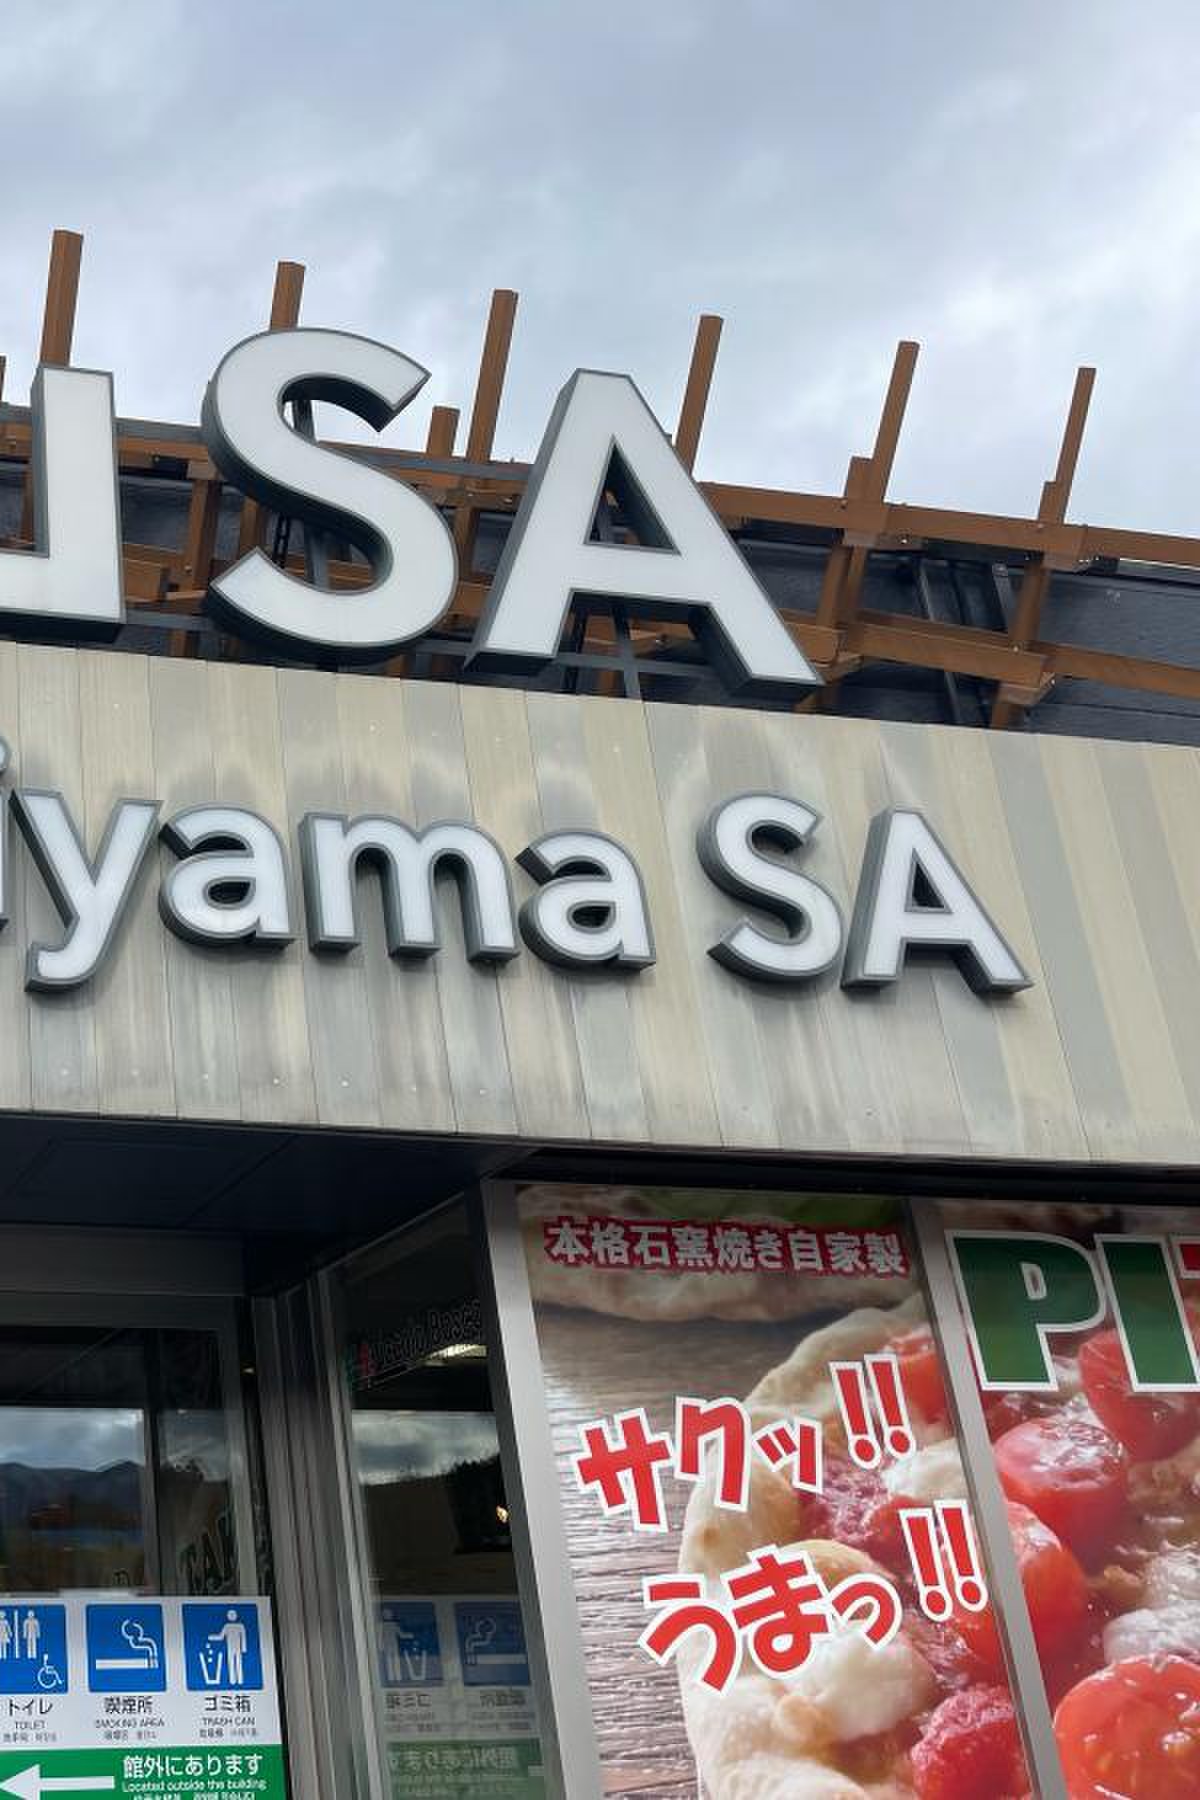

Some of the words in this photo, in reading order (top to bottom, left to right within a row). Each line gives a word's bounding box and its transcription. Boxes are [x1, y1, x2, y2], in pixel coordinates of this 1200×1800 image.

[697, 794, 1032, 996] SA
[547, 1219, 907, 1274] 本格石窯焼き自家製
[946, 1231, 1200, 1392] PI
[8, 1699, 52, 1715] トイレ
[105, 1697, 153, 1714] 喫煙所
[205, 1696, 251, 1713] ゴミ箱
[123, 1753, 263, 1778] 館外にあります
[167, 1780, 205, 1791] outside
